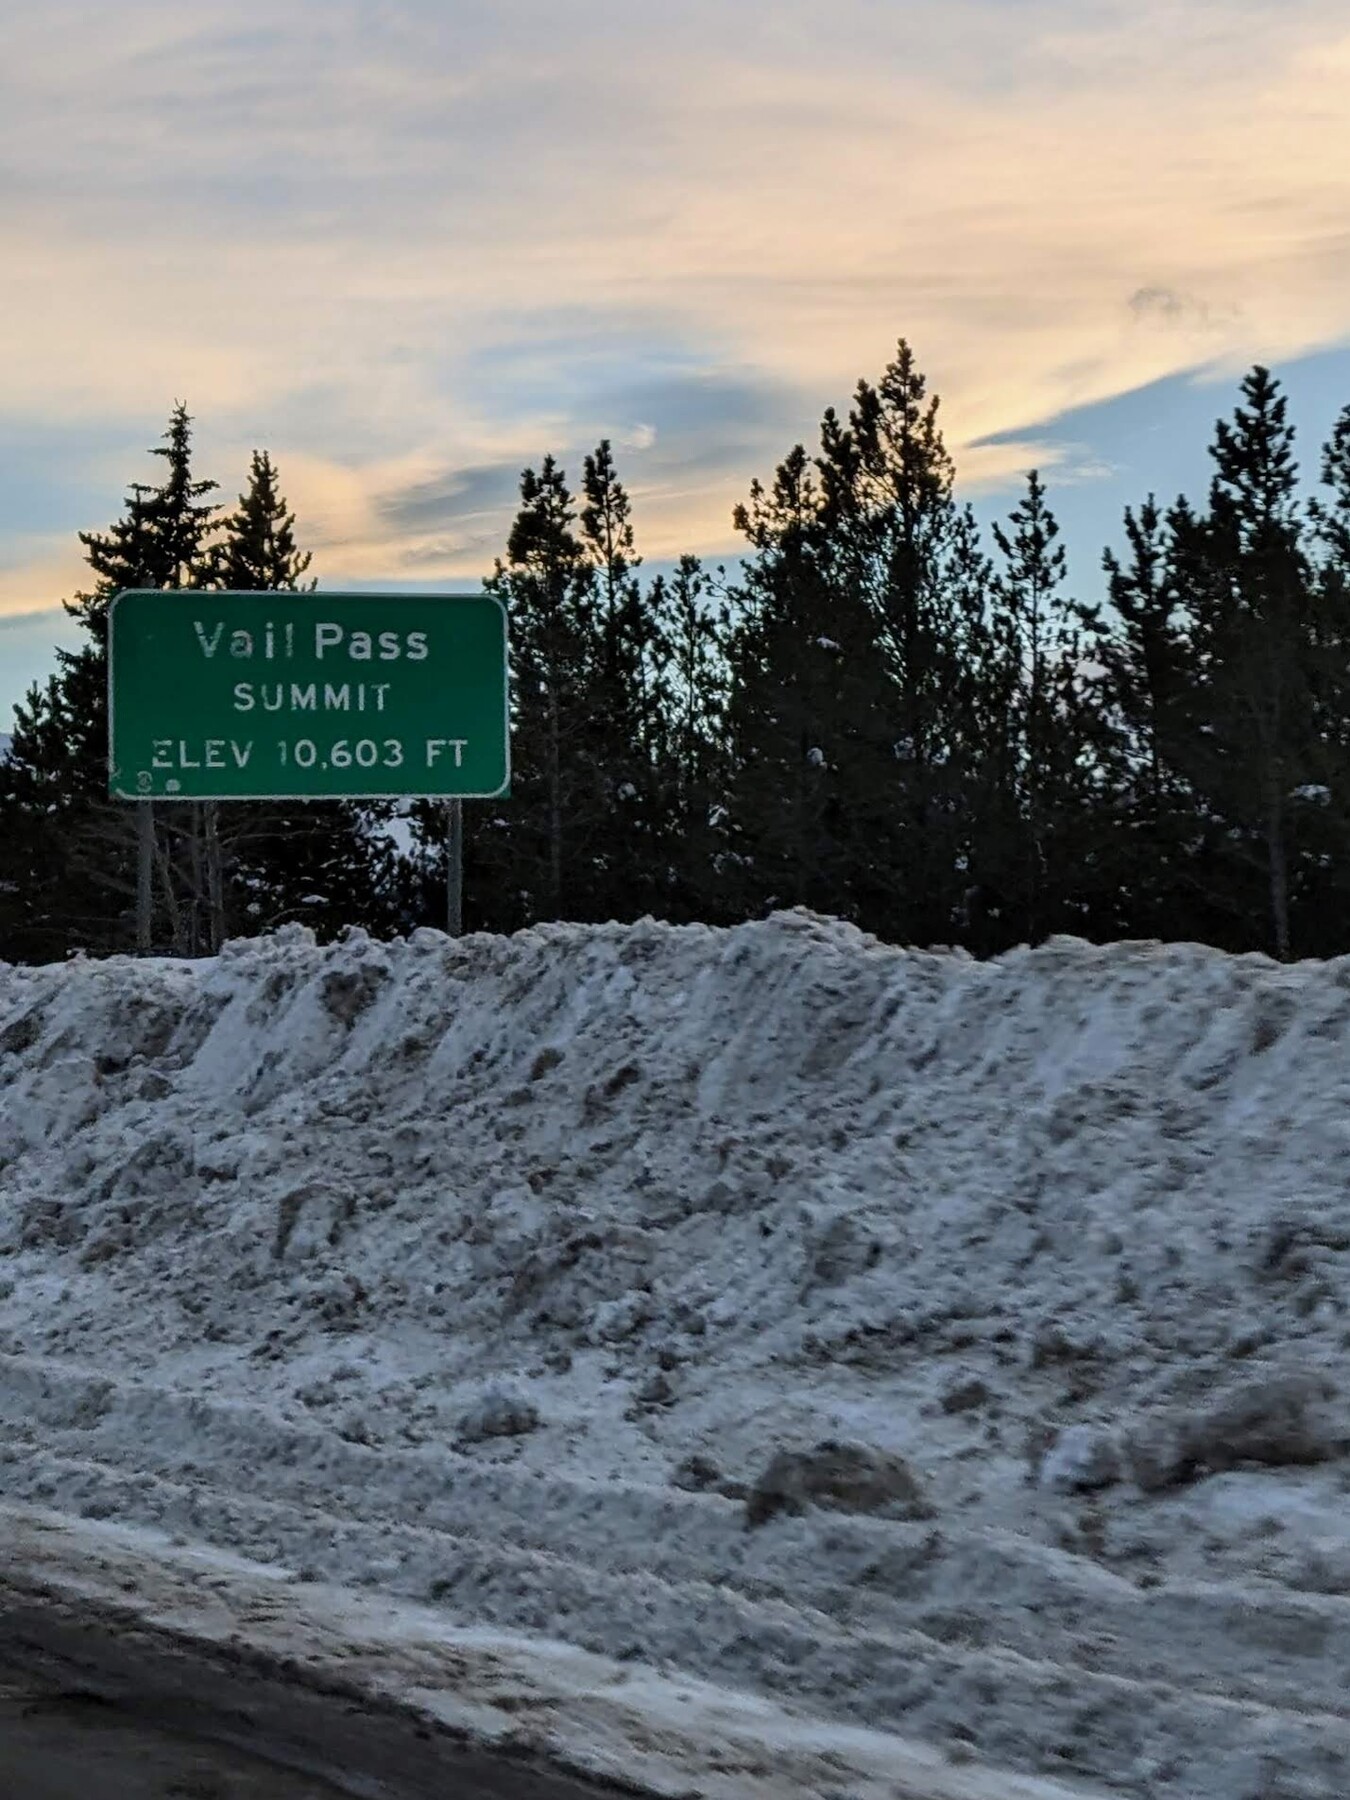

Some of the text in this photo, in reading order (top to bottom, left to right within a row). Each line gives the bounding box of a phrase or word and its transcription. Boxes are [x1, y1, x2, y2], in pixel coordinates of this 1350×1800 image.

[193, 620, 429, 660] Vail Pass
[233, 682, 391, 711] SUMMIT
[152, 739, 253, 768] ELEV
[425, 739, 468, 767] FT
